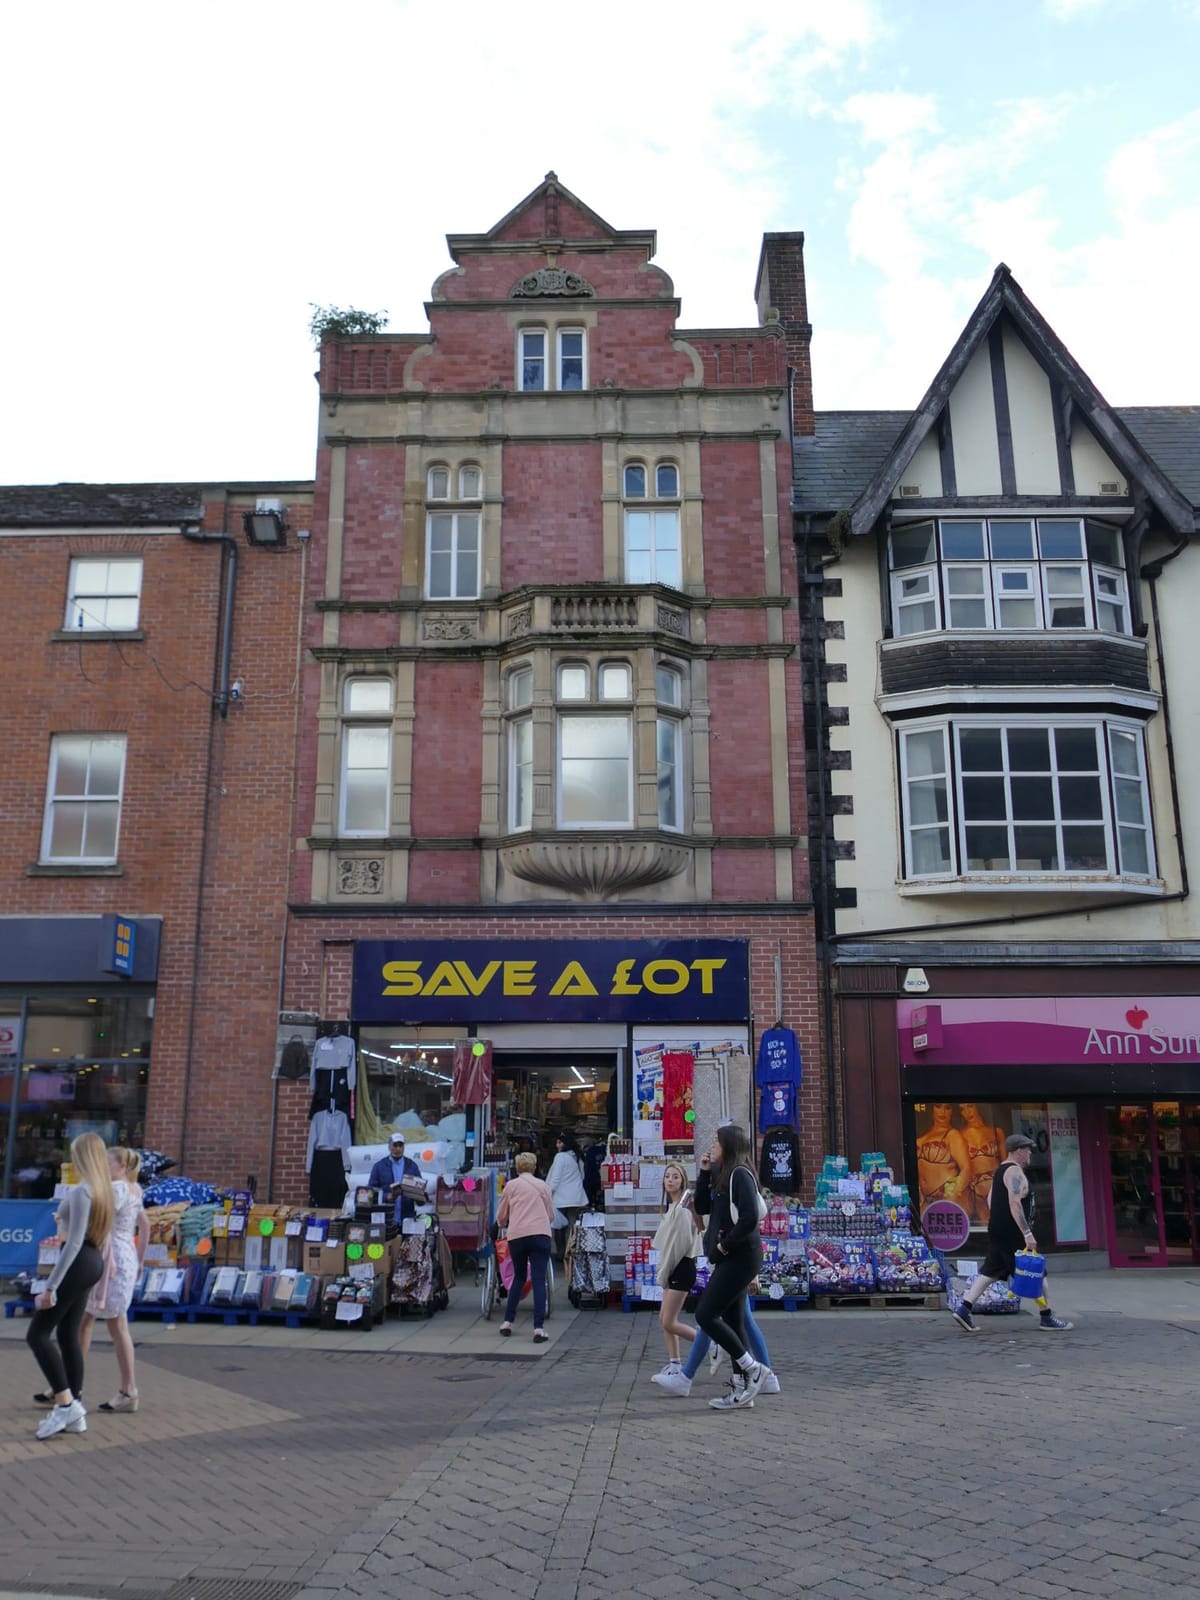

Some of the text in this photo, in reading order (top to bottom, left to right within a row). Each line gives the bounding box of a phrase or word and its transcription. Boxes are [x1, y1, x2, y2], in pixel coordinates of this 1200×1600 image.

[381, 960, 538, 997] SAVE
[549, 960, 600, 997] A
[1083, 1027, 1141, 1055] Ann
[928, 1213, 963, 1225] FREE
[0, 1229, 33, 1243] GGS
